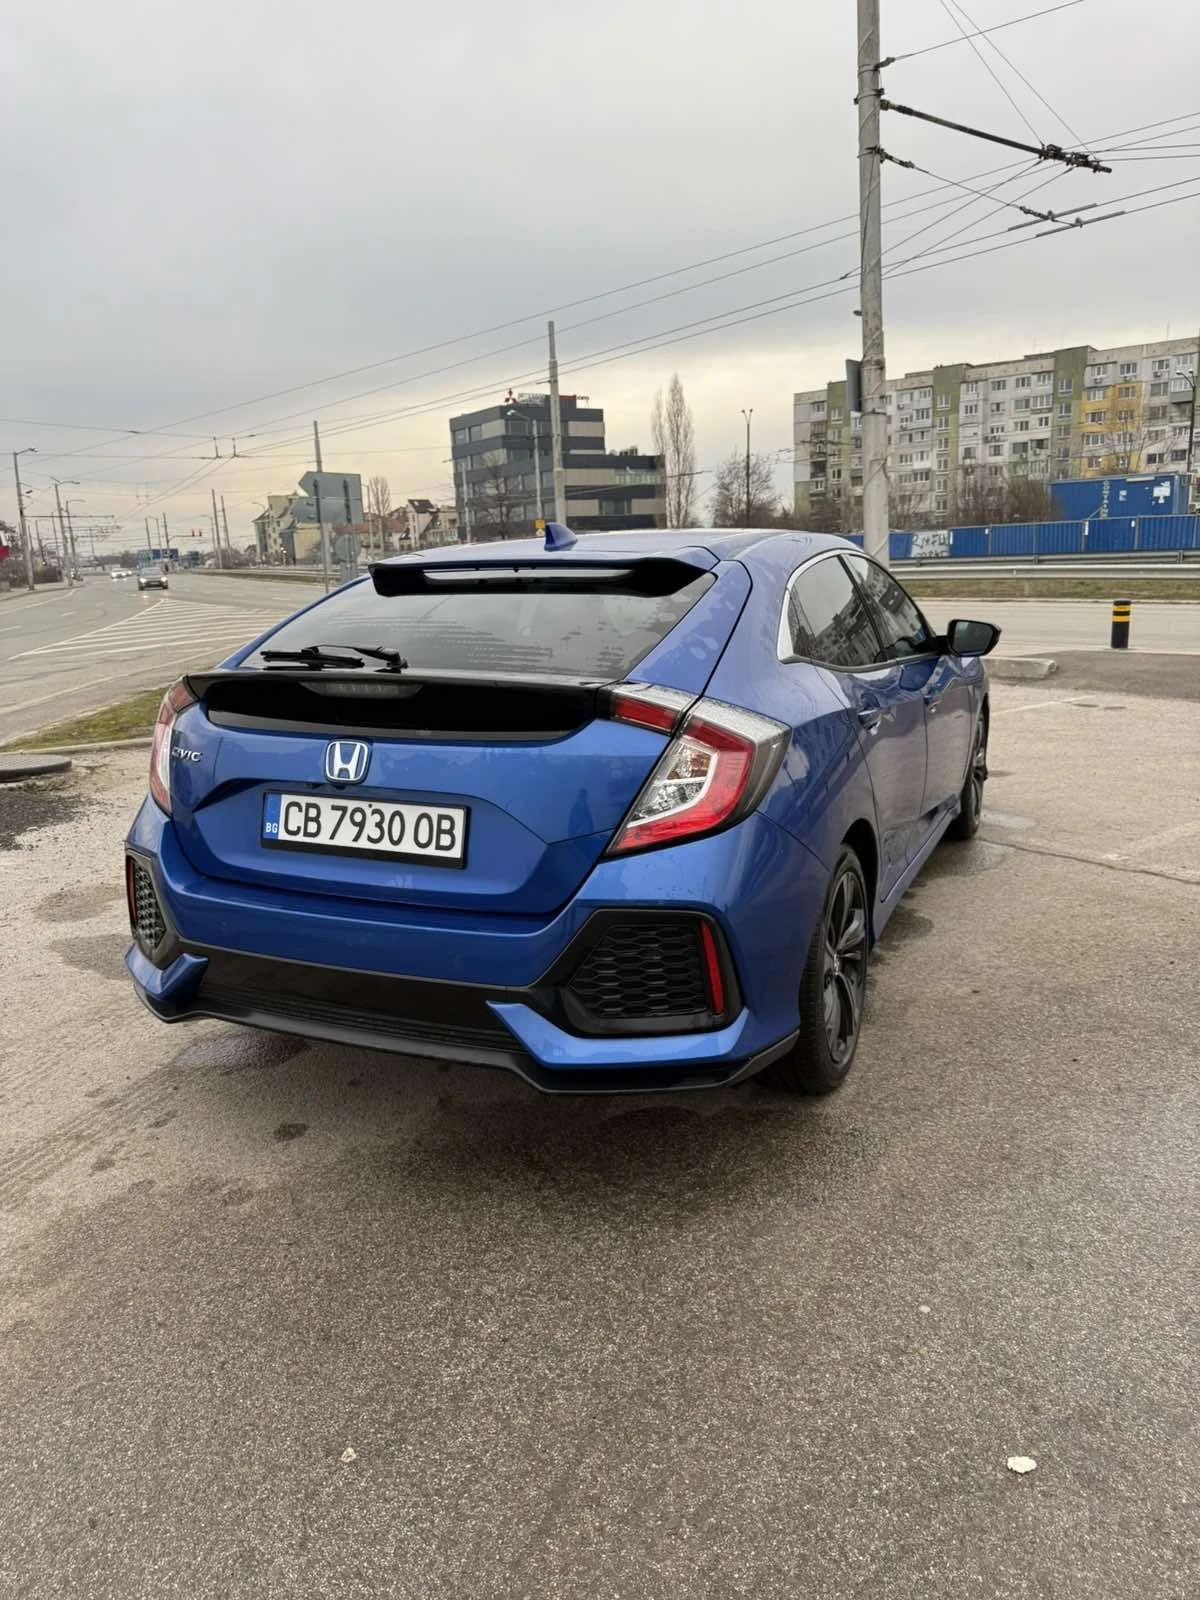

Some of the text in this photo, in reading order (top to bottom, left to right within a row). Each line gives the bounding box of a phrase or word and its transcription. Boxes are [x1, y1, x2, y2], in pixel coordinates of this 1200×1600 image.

[265, 822, 279, 834] BG
[284, 801, 322, 838] CB
[329, 805, 406, 847] 7930
